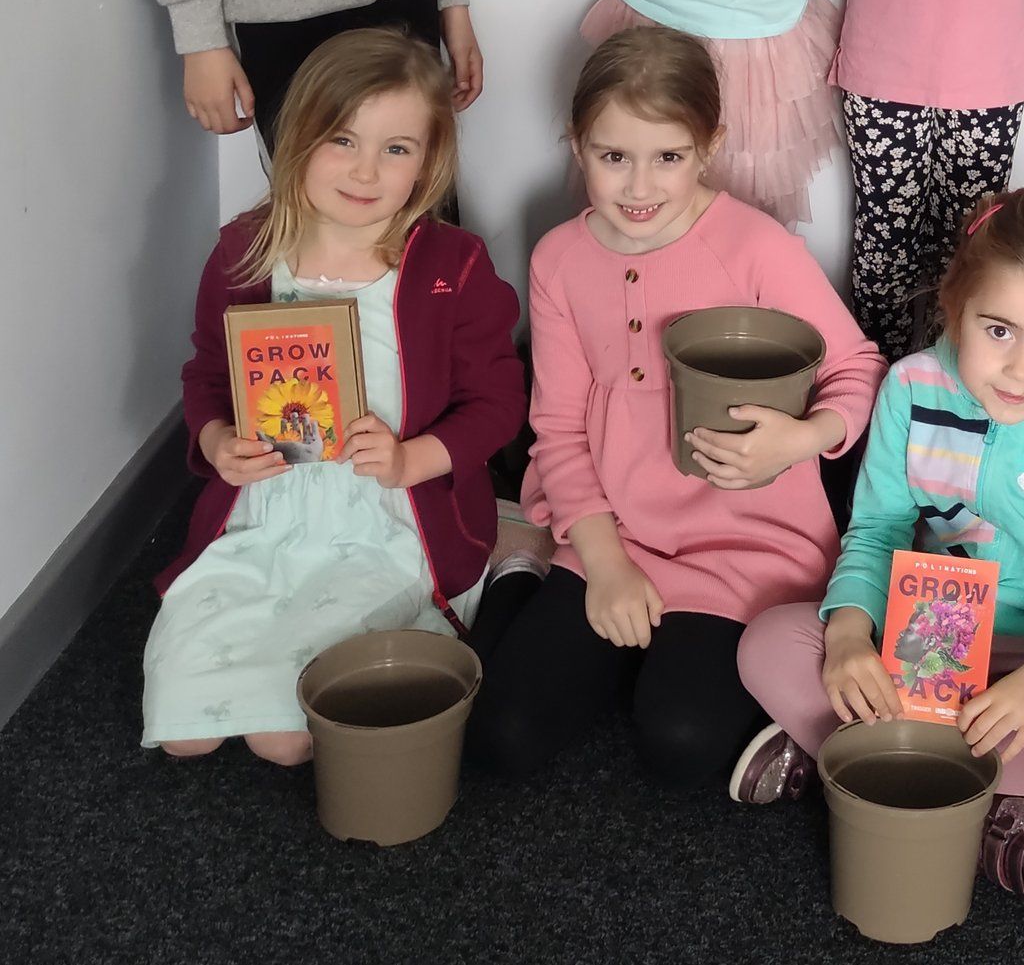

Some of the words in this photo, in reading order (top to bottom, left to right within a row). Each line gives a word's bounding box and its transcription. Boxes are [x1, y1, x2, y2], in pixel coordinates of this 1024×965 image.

[246, 343, 331, 363] GROW
[248, 365, 334, 386] PACK
[899, 574, 990, 605] GROW
